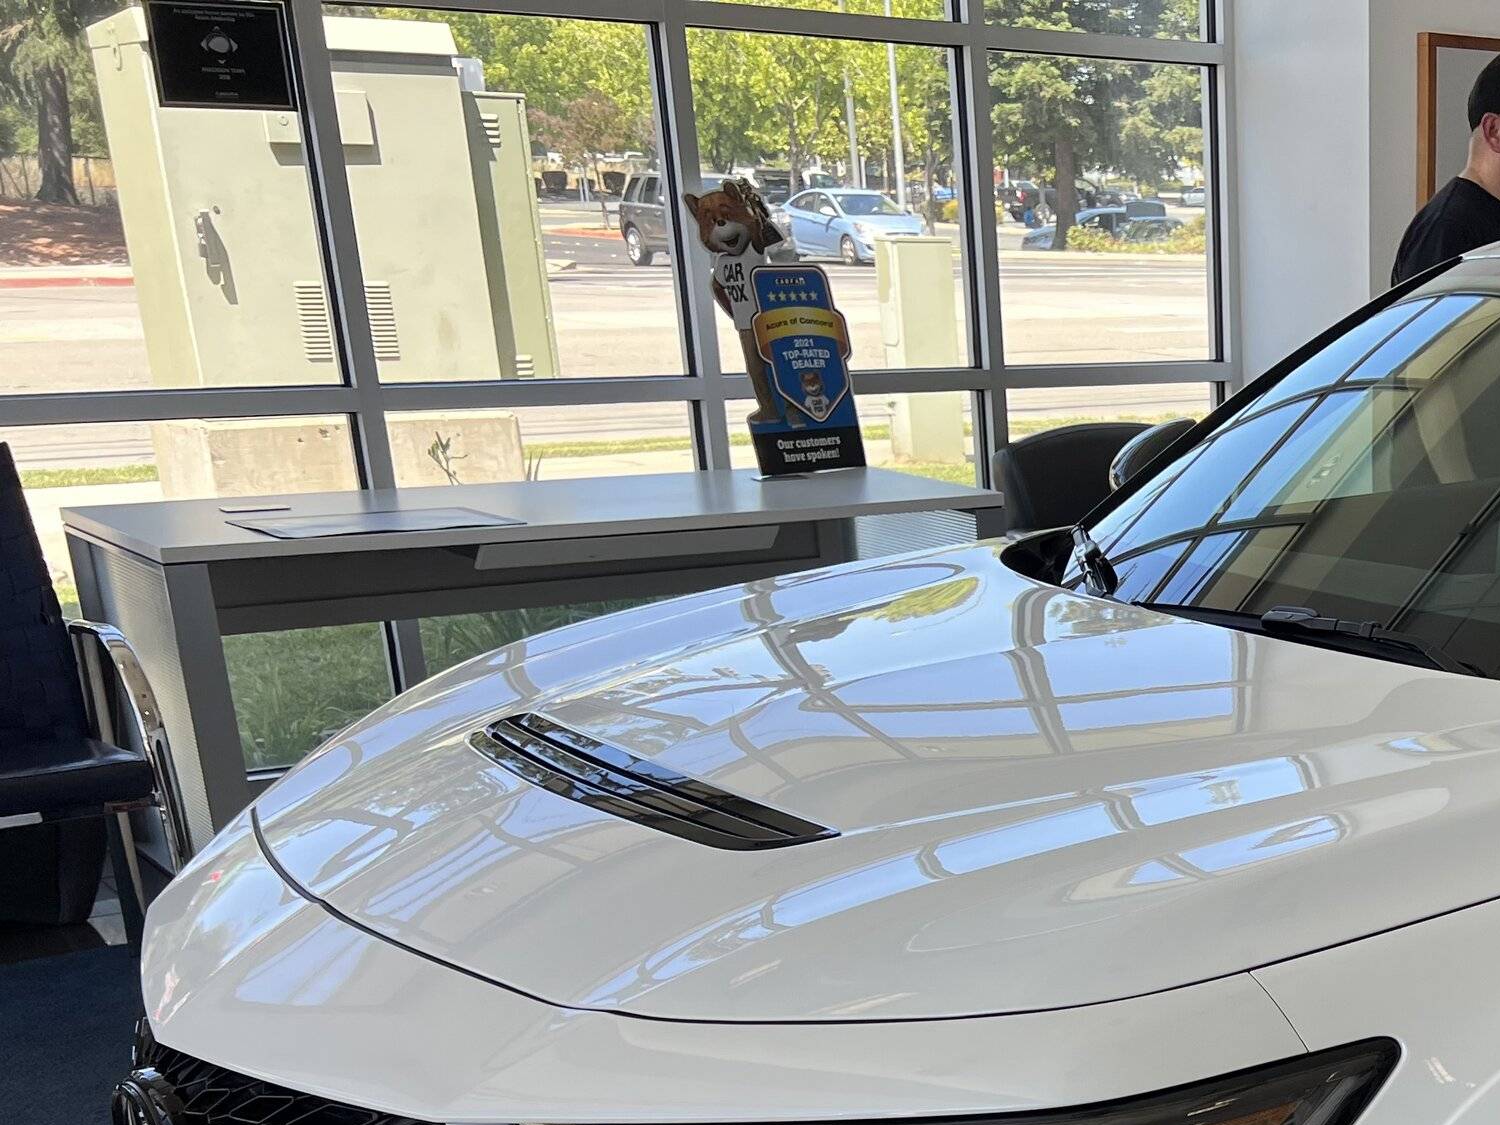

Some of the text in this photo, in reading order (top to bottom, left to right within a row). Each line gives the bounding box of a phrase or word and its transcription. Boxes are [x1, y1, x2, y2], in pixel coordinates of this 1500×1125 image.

[723, 262, 744, 283] CAR
[726, 284, 748, 303] FOX
[766, 319, 789, 330] Acura
[793, 338, 814, 348] 2021
[782, 349, 830, 361] TOP-RATED
[792, 359, 825, 370] DEALER
[777, 436, 841, 450] Our customers
[783, 448, 840, 463] have spoken!
